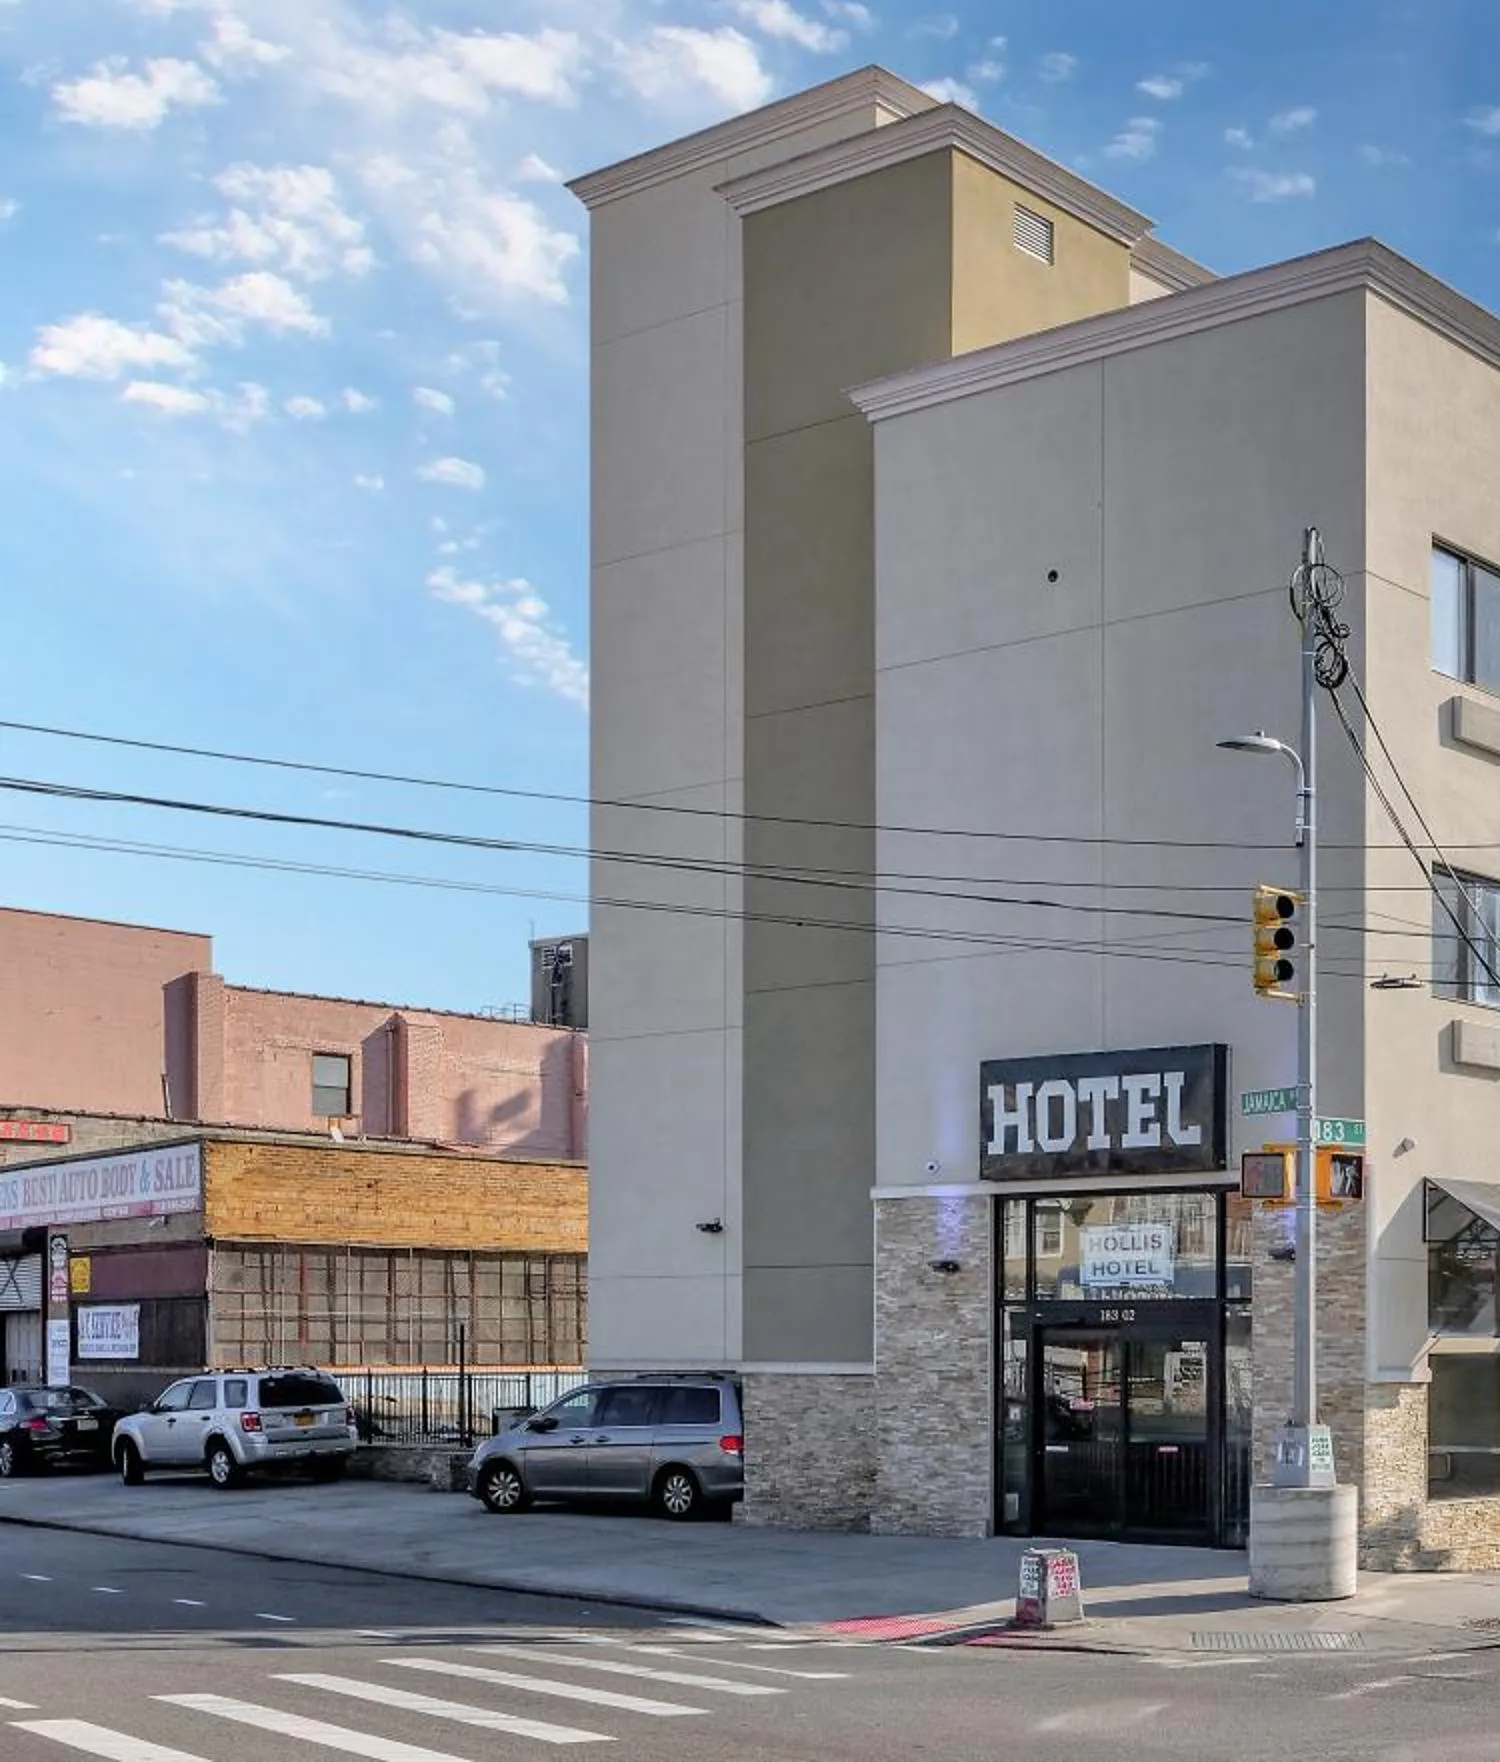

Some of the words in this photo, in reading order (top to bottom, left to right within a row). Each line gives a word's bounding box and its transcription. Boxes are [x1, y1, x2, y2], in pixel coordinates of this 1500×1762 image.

[987, 1071, 1201, 1155] HOTEL
[59, 1167, 98, 1204] AUTO
[153, 1154, 196, 1193] SALE
[1088, 1234, 1162, 1252] HOLLIS
[1092, 1261, 1160, 1276] HOTEL
